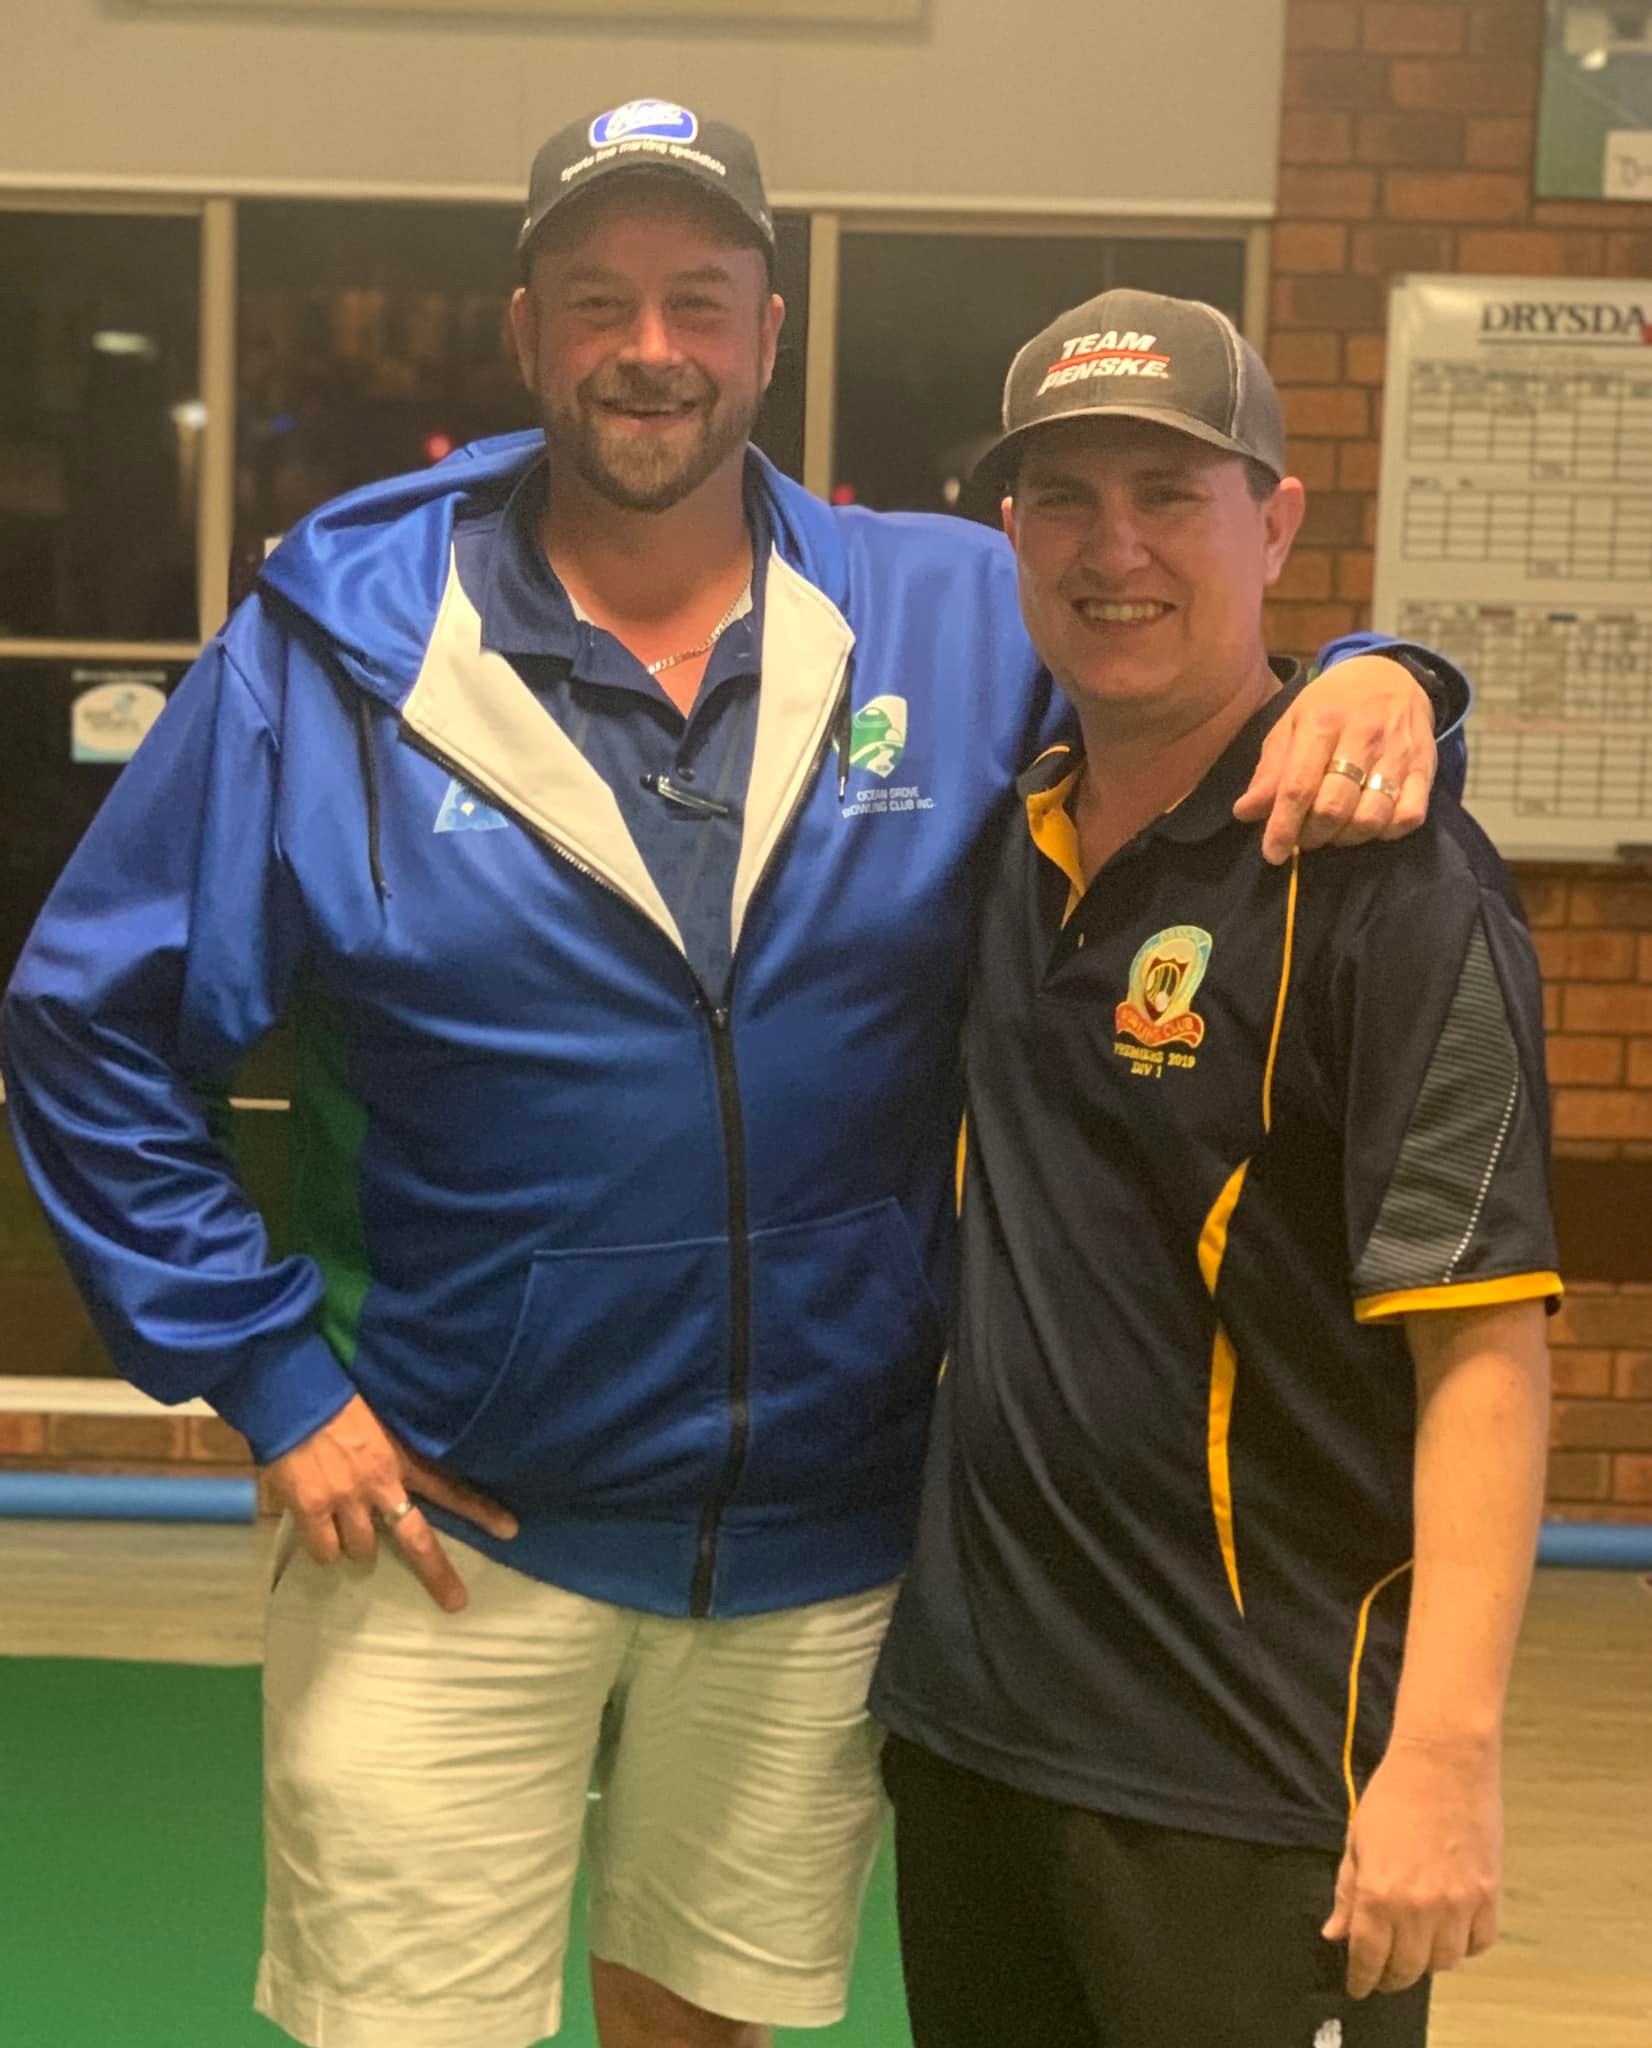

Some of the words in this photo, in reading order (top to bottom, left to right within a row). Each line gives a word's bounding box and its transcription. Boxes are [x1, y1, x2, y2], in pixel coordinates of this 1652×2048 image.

[561, 157, 595, 181] Sports
[595, 147, 617, 164] line
[619, 140, 668, 154] marking
[670, 146, 726, 176] specialists
[1061, 331, 1157, 361] TEAM
[1036, 358, 1169, 398] PENSKE
[857, 790, 888, 801] OCEAN
[889, 787, 919, 798] GROVE
[842, 801, 888, 818] BOWLING
[889, 799, 915, 811] CLUB
[1114, 1043, 1164, 1063] PREMIERS
[1131, 1061, 1153, 1076] DIV
[1156, 1065, 1162, 1078] 1
